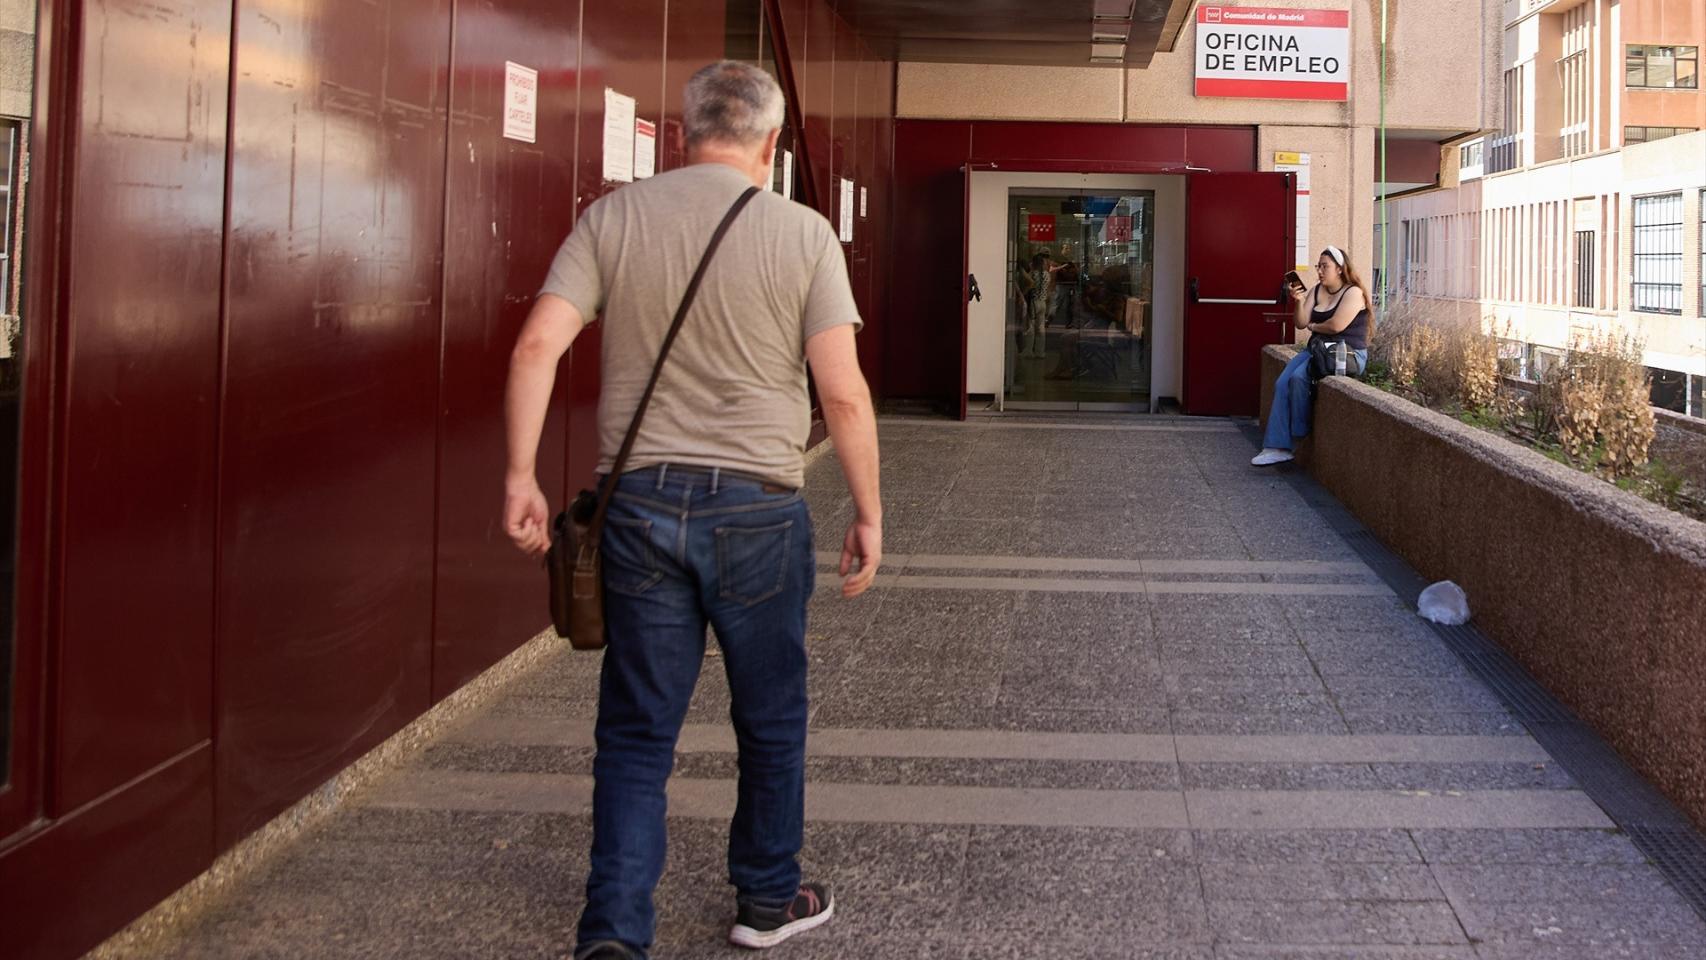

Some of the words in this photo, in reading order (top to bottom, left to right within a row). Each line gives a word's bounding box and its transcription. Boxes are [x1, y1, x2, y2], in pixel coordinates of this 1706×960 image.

[1223, 12, 1266, 20] Comunidad
[1279, 13, 1304, 21] Madrid
[1205, 32, 1300, 52] OFICINA
[1205, 53, 1235, 71] DE
[1244, 54, 1339, 74] EMPLEO
